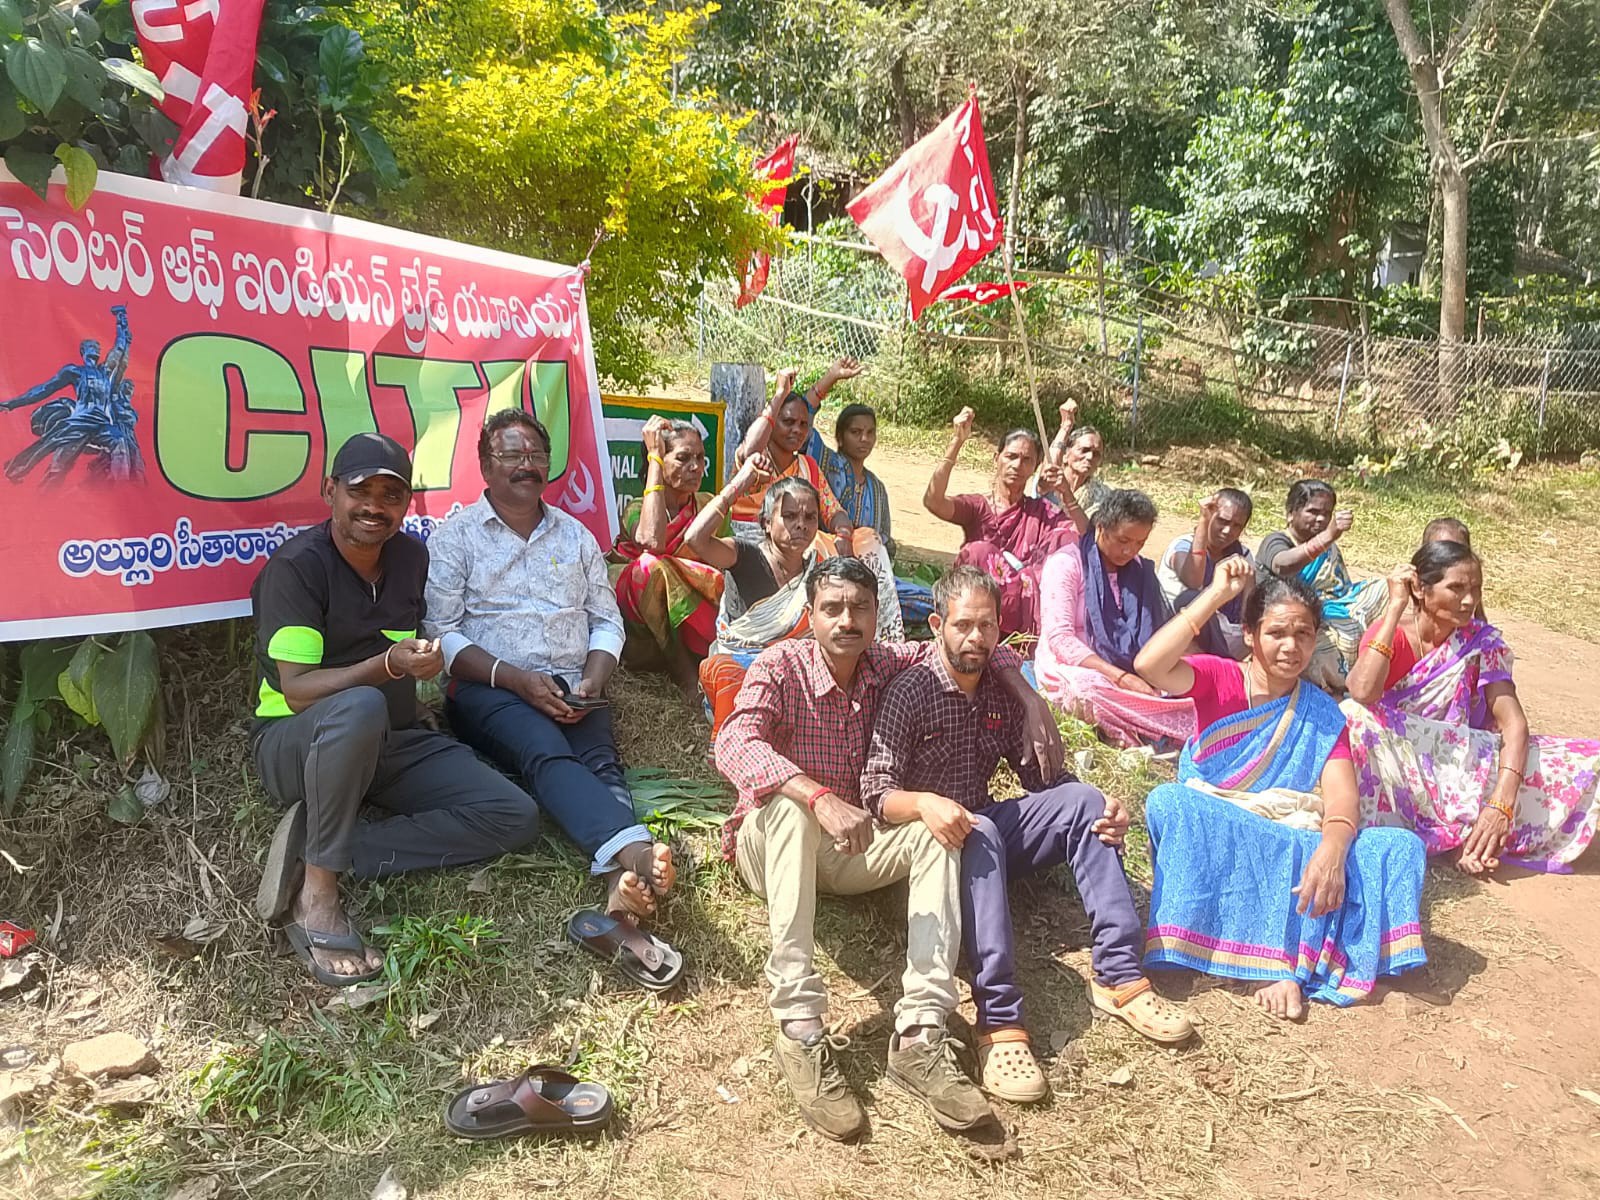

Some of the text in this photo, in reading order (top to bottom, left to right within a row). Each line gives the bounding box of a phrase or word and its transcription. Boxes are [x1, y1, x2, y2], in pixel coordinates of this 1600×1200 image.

[161, 228, 225, 320] ఆఫ్
[231, 246, 395, 327] ఇండియన్
[400, 256, 449, 353] ట్రేడ్
[154, 332, 570, 502] CITU
[611, 454, 639, 480] NAL
[59, 533, 176, 586] అల్లూరి
